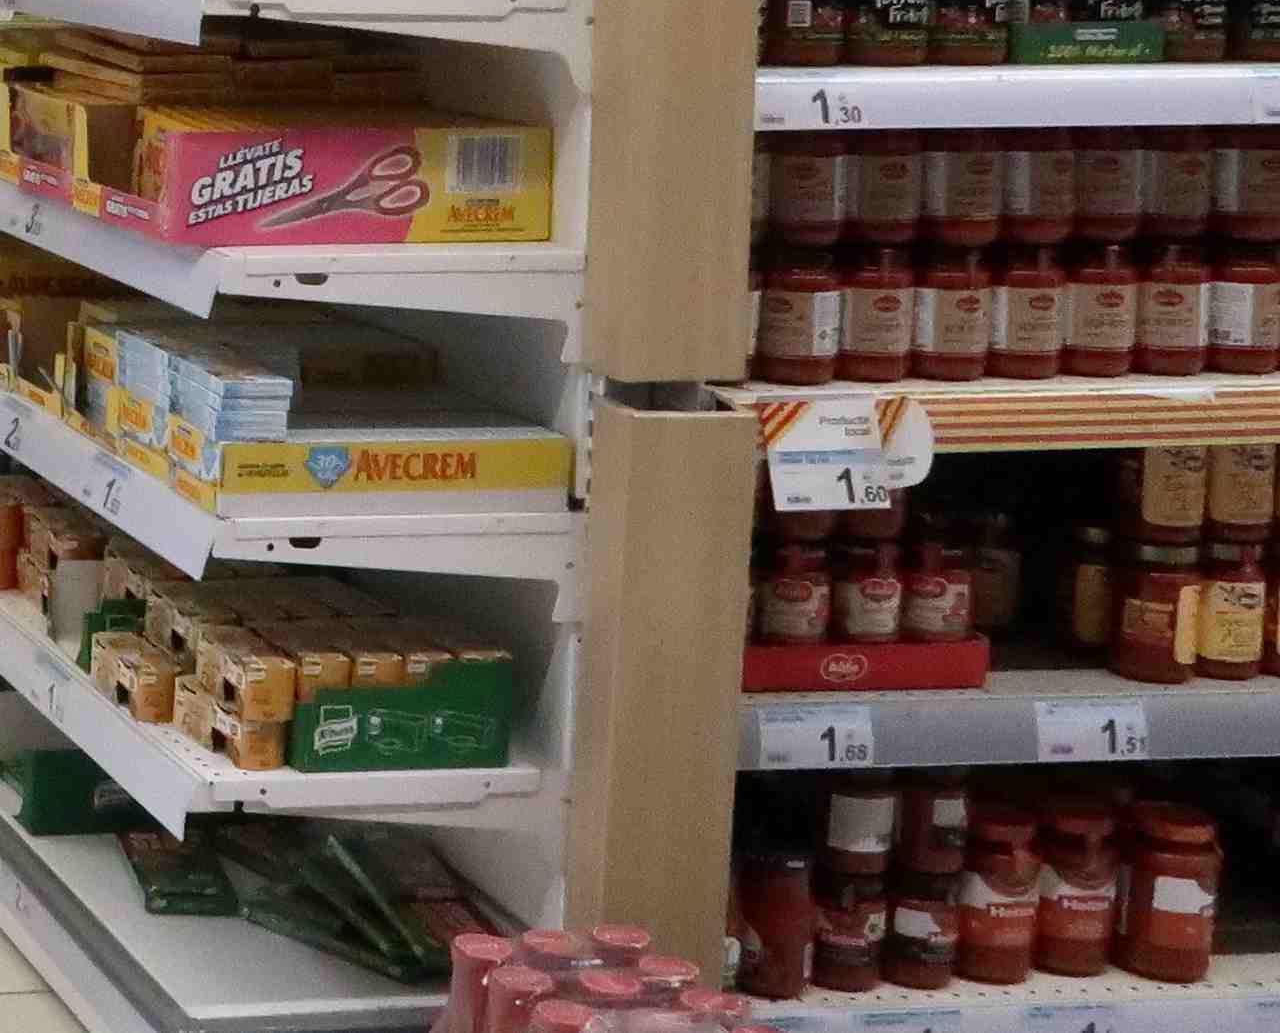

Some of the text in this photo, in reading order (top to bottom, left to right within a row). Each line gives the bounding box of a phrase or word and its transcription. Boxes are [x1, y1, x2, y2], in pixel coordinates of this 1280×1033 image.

[190, 148, 305, 206] GRATIS
[188, 199, 234, 225] ESTAS
[352, 449, 477, 481] AVECREM
